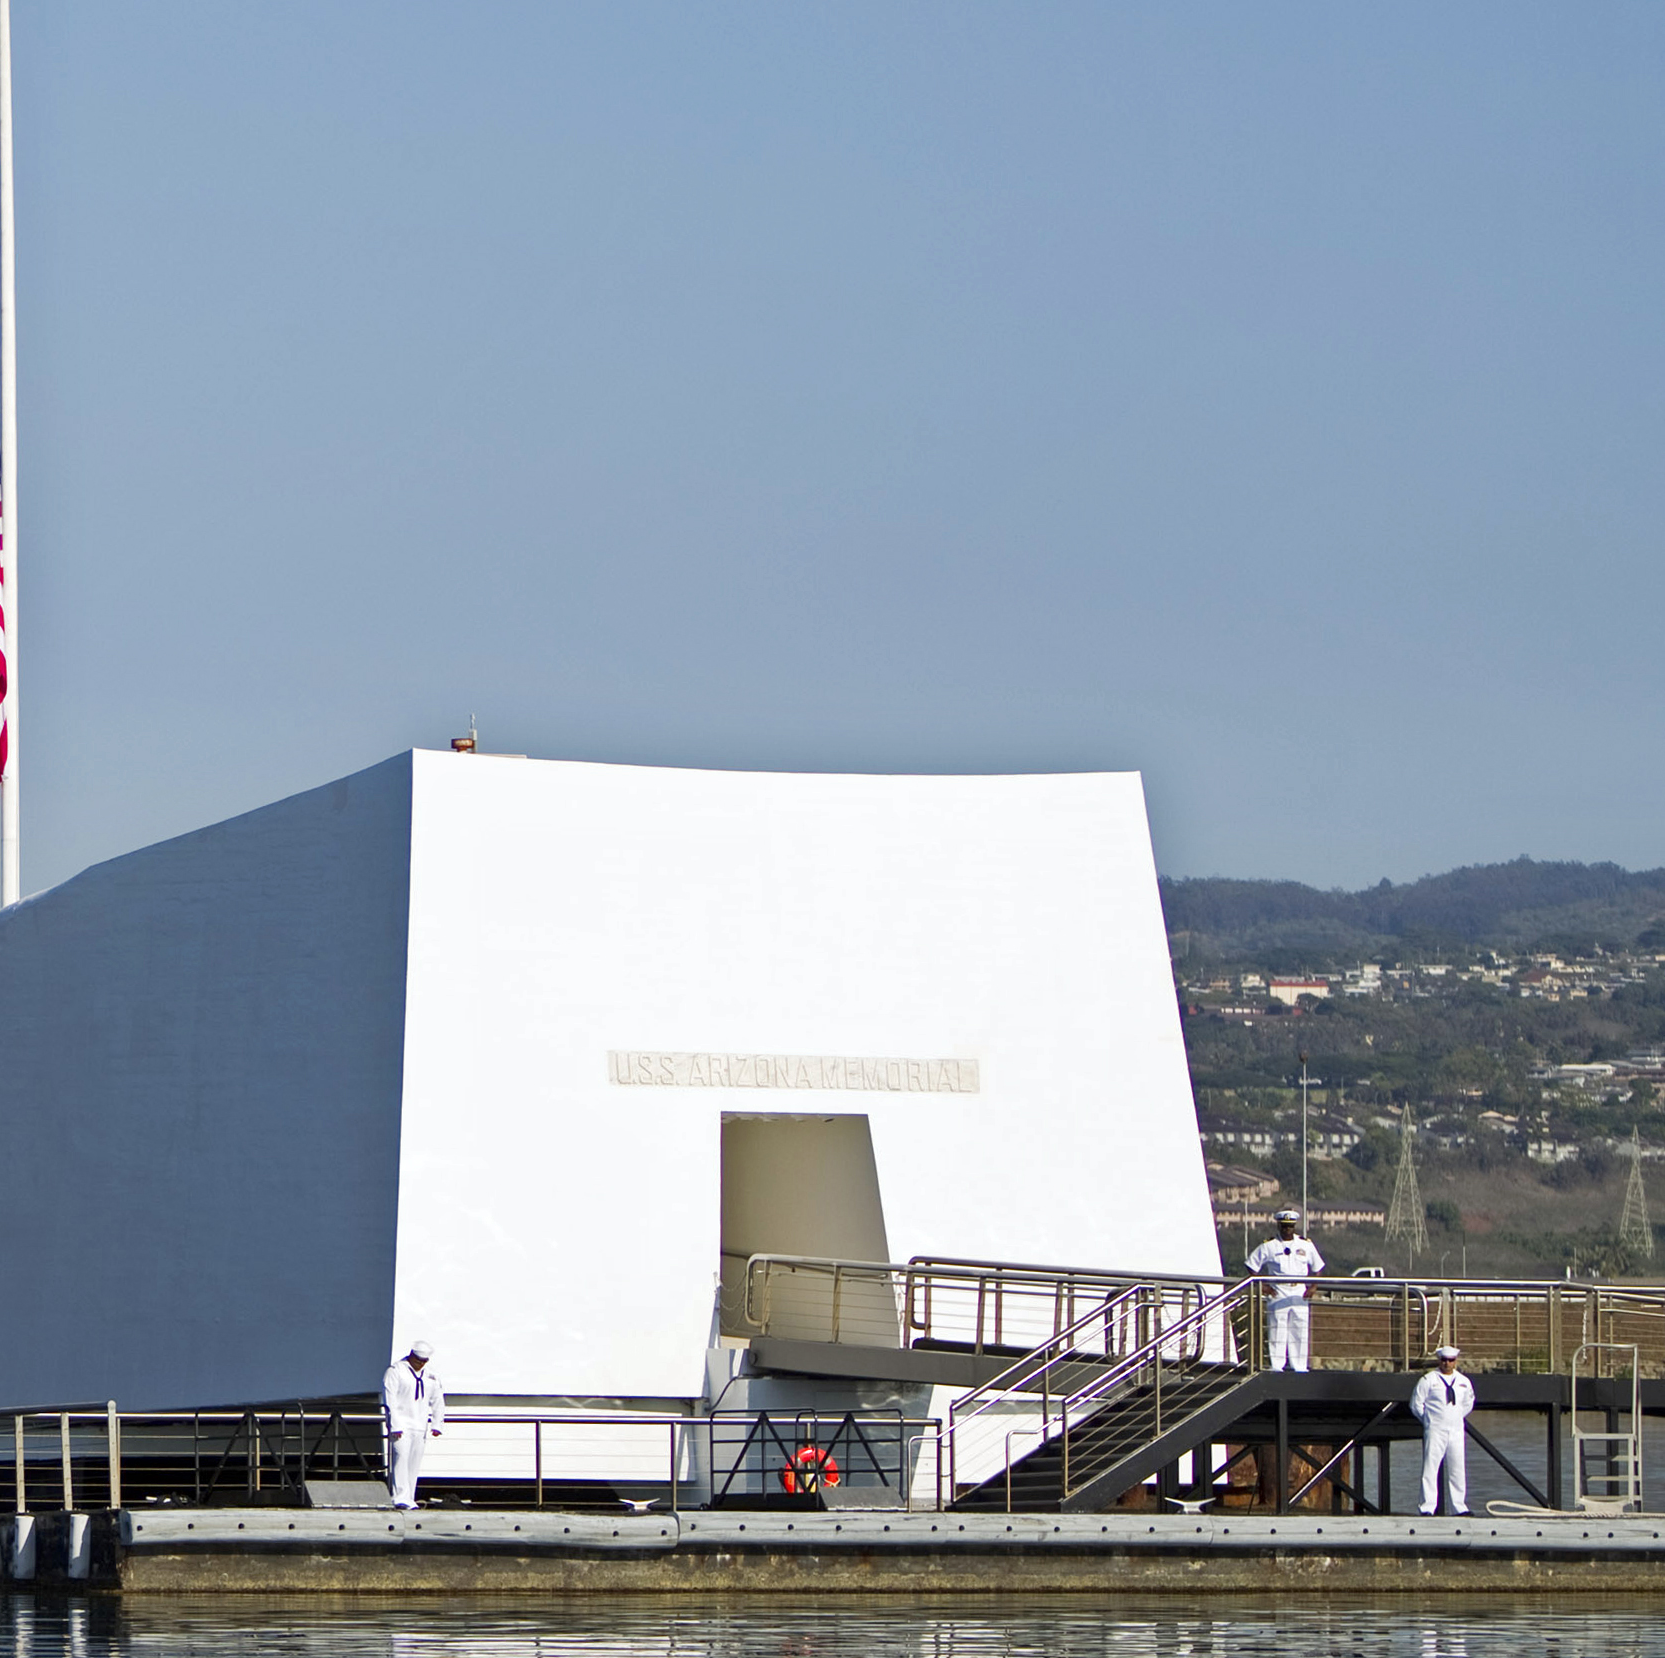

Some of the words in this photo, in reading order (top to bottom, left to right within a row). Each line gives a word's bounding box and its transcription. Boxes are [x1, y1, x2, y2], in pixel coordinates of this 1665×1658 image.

[614, 1052, 680, 1086] U.S.S.
[687, 1053, 813, 1089] ARIZONA
[820, 1056, 973, 1093] MEMORIAL
